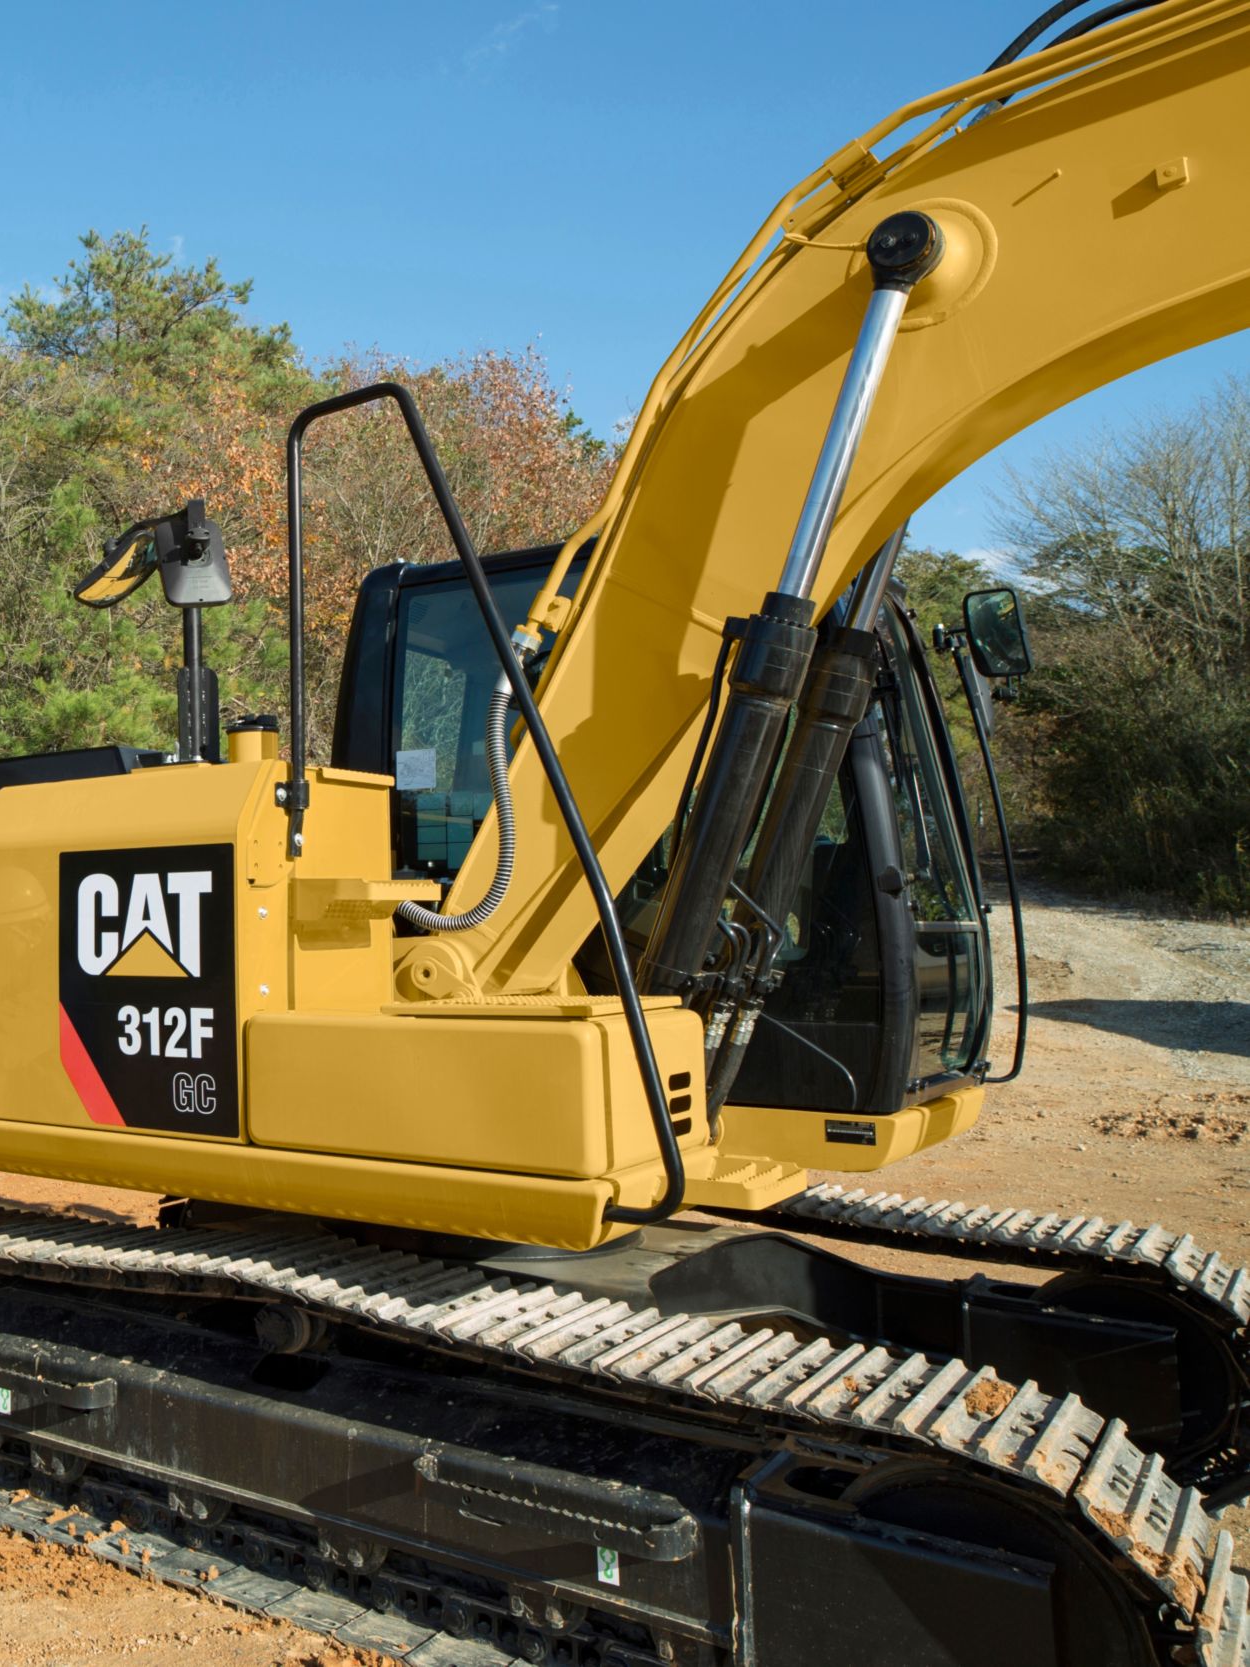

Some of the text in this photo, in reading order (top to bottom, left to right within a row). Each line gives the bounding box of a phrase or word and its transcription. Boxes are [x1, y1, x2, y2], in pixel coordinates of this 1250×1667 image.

[78, 871, 212, 977] CAT
[117, 1005, 214, 1058] 312F
[173, 1072, 216, 1114] GC
